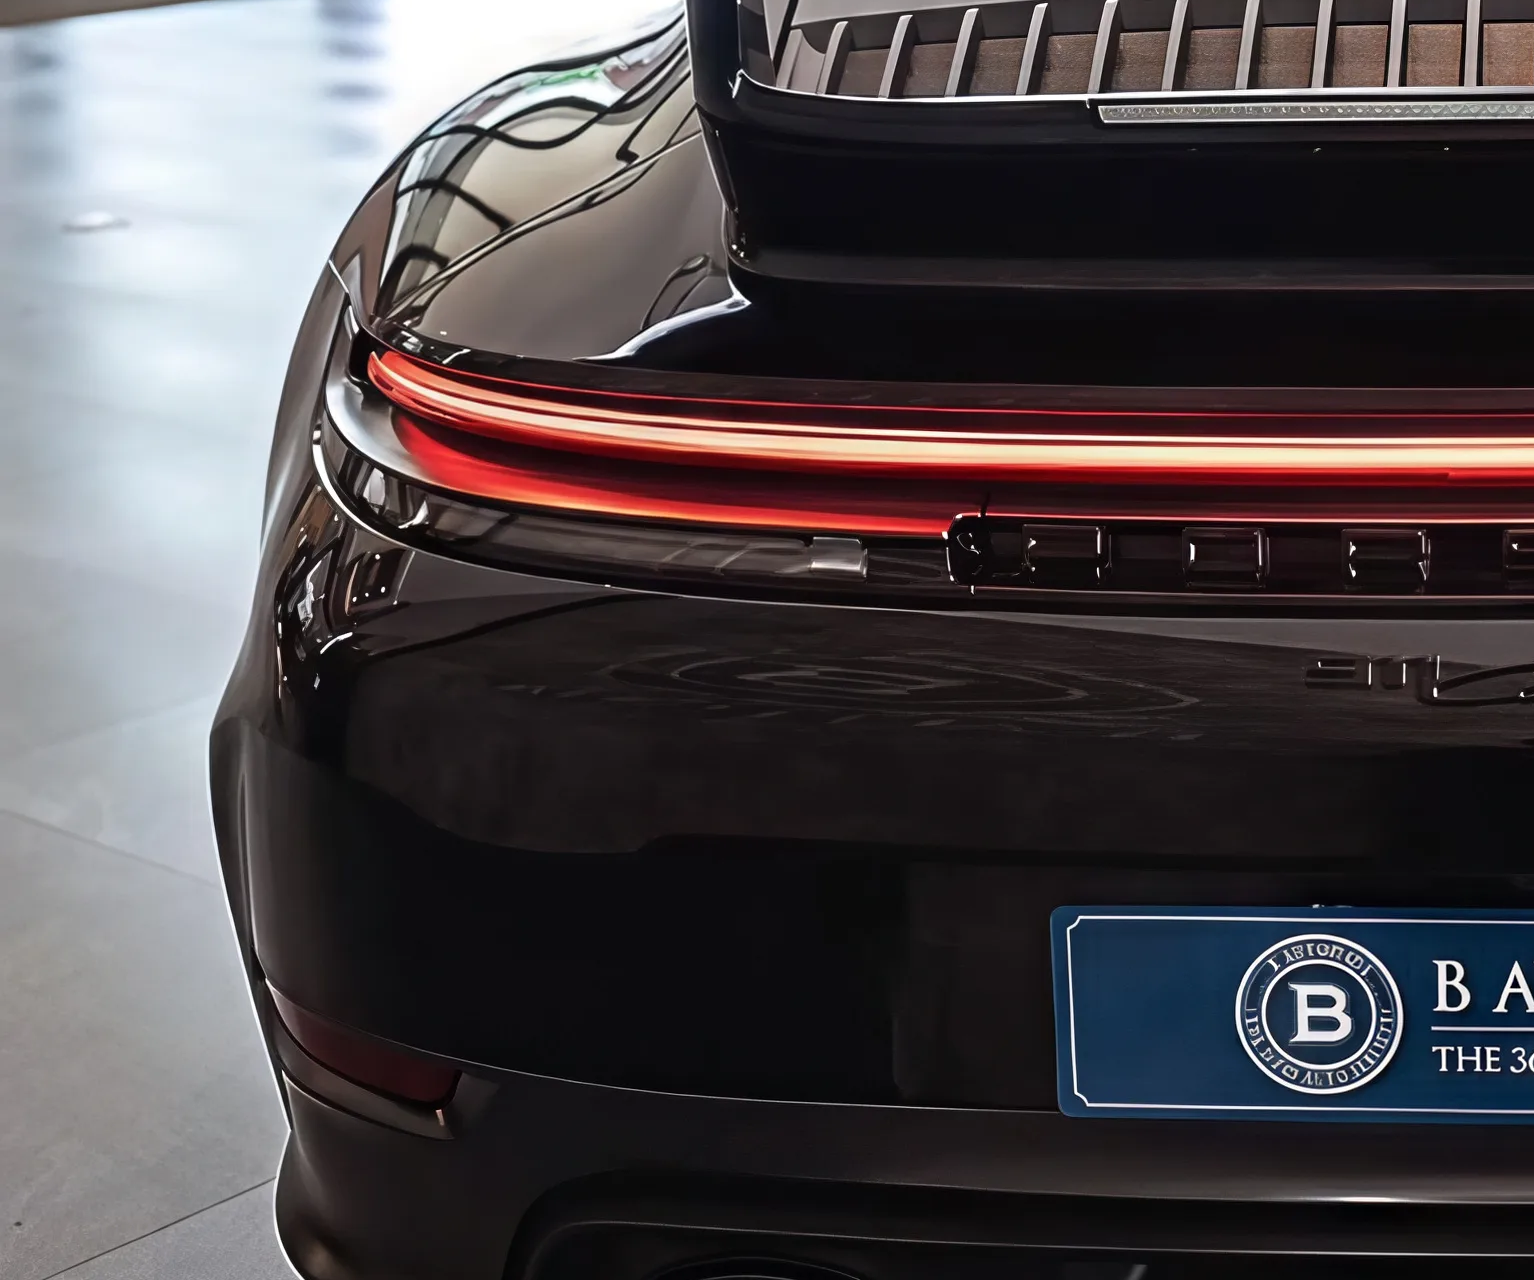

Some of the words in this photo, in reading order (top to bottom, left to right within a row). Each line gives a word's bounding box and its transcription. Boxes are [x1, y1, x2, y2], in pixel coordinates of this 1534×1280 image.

[1432, 959, 1471, 1012] B
[1287, 982, 1352, 1043] B
[1431, 1046, 1501, 1072] THE
